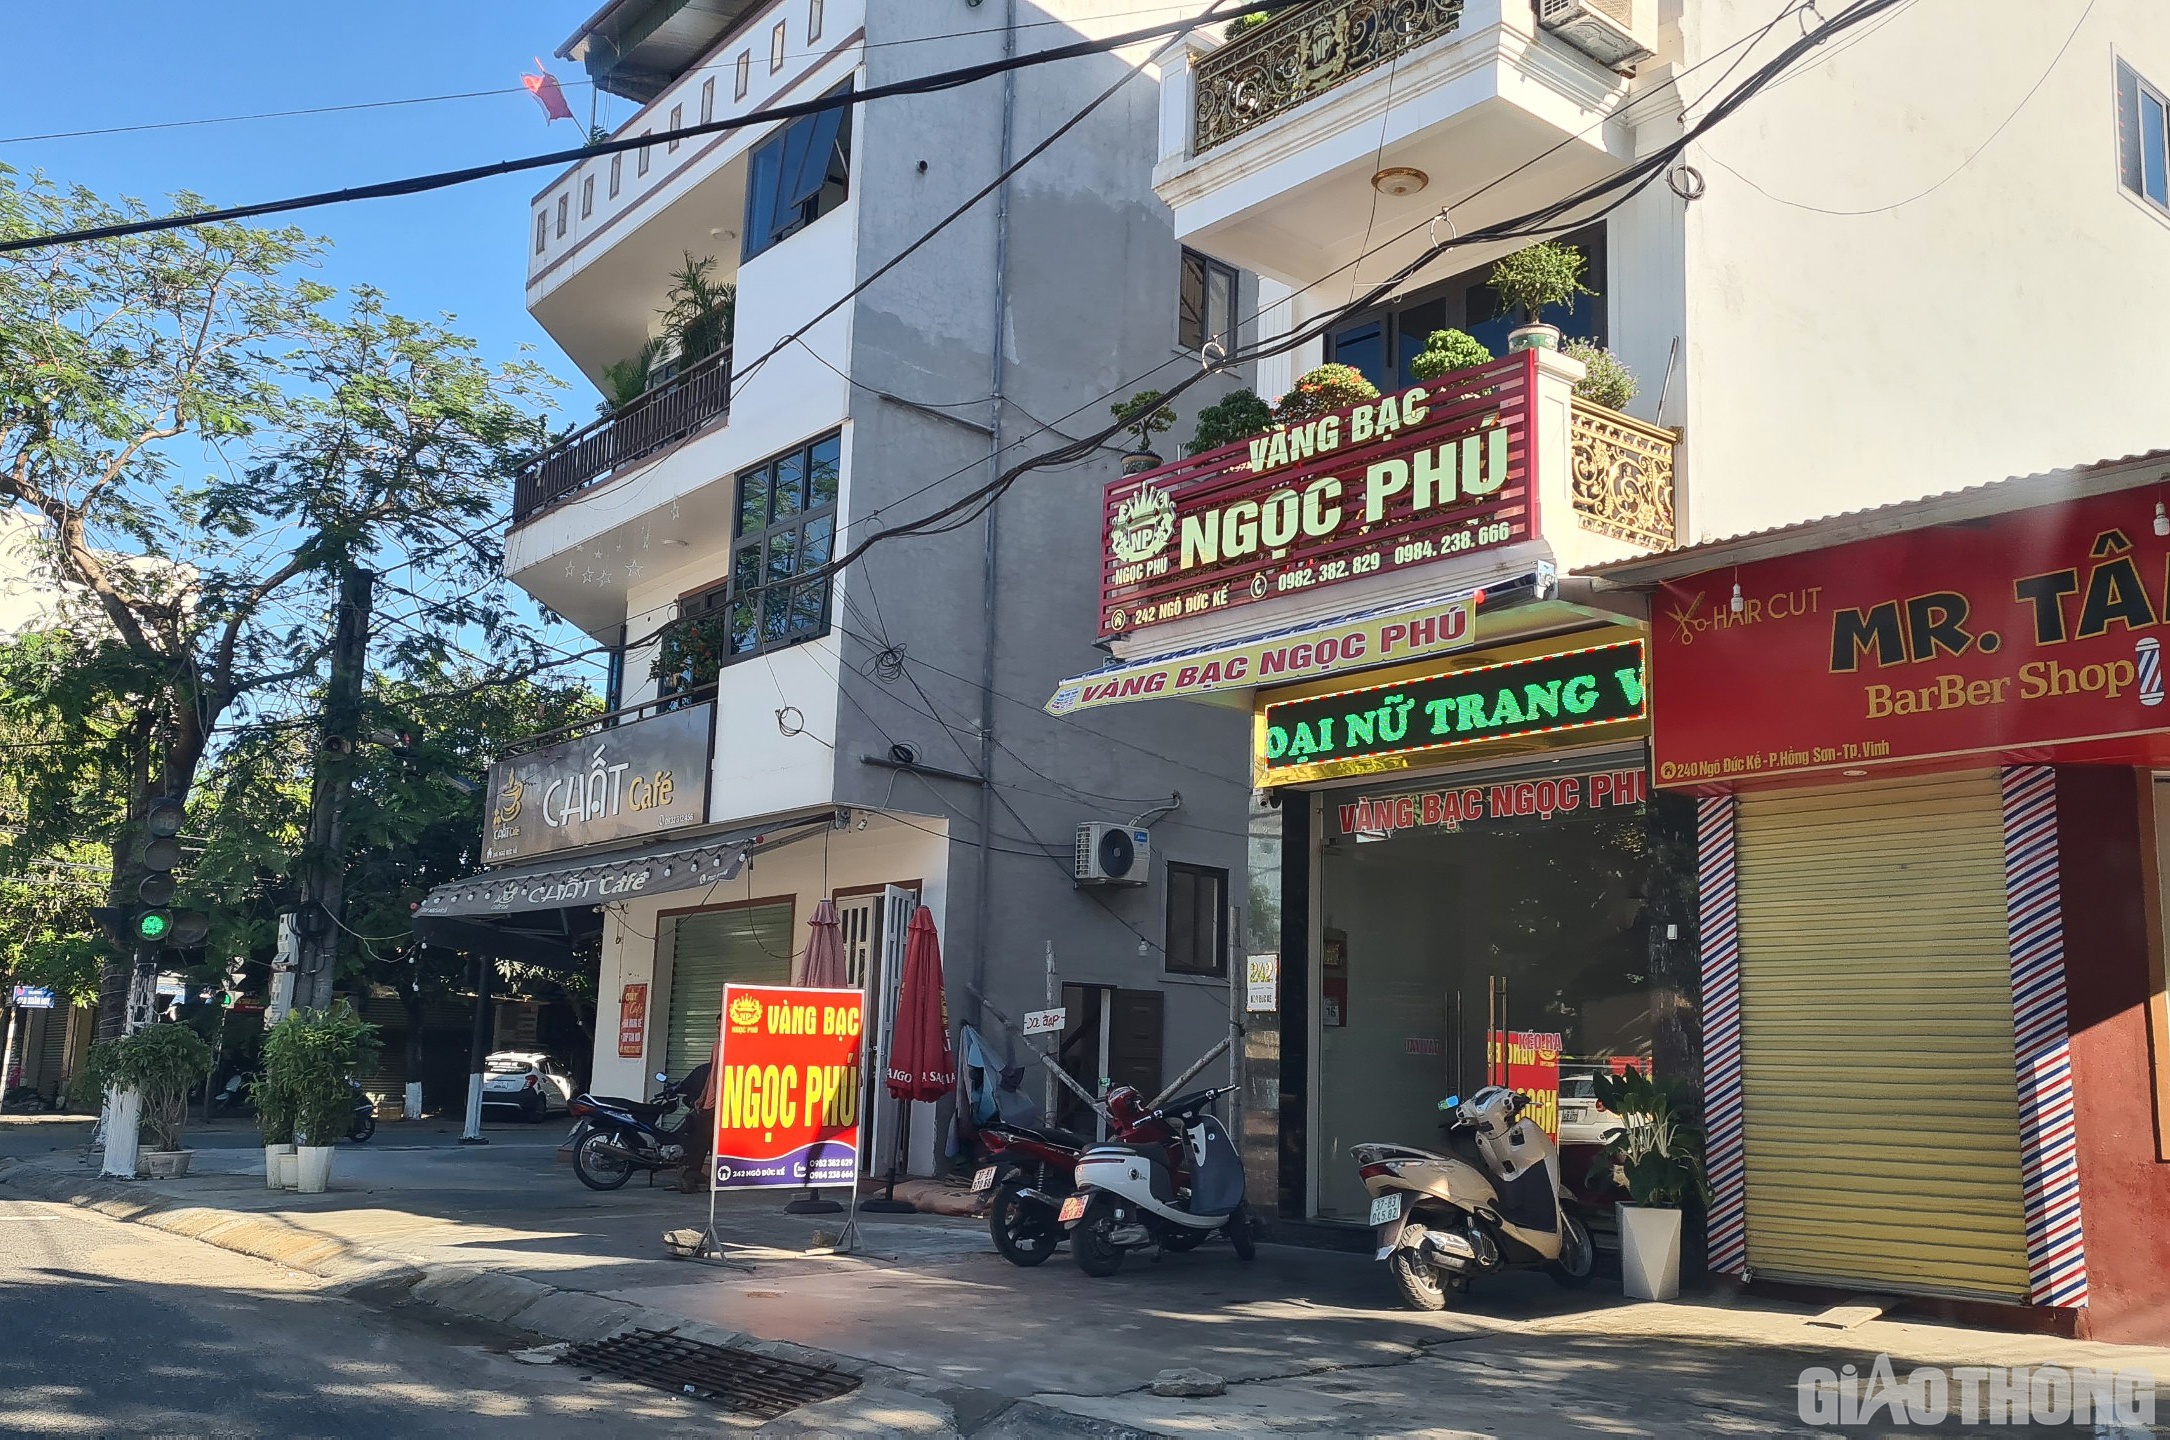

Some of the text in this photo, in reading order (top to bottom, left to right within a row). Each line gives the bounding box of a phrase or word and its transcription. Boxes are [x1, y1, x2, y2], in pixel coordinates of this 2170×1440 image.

[1312, 35, 1331, 64] NP
[1249, 387, 1430, 473] VÀNG BẠC
[1180, 412, 1509, 570] NGỌC PHÚ
[1131, 527, 1153, 553] NP
[1115, 554, 1169, 586] NGỌC PHÚ
[1134, 583, 1230, 625] 242 NGÔ ĐỨC KẾ
[1713, 587, 1822, 630] HAIR CUT
[1828, 526, 2170, 674] MR. TÂ
[1081, 670, 1167, 703] VÀNG
[1175, 656, 1250, 690] BẠC
[1259, 635, 1367, 676] NGỌC
[1381, 606, 1468, 653] PHÚ
[1346, 692, 1416, 747] NỮ
[1425, 674, 1600, 736] TRANG
[1865, 658, 2136, 719] BarBer Shop
[1677, 762, 1699, 778] 240
[1700, 759, 1721, 778] Ngô
[1723, 756, 1744, 773] Đức
[1746, 750, 1762, 770] Kế
[1862, 739, 1890, 757] Vinh
[541, 744, 674, 827] CHẤT Café
[1338, 794, 1414, 834] VÀNG
[1421, 787, 1483, 830] BẠC
[1491, 774, 1580, 820] NGỌC
[598, 870, 646, 896] Café
[1250, 961, 1273, 983] 242
[767, 1000, 860, 1042] VÀNG BẠC
[721, 1053, 857, 1143] NGỌC PHÚ
